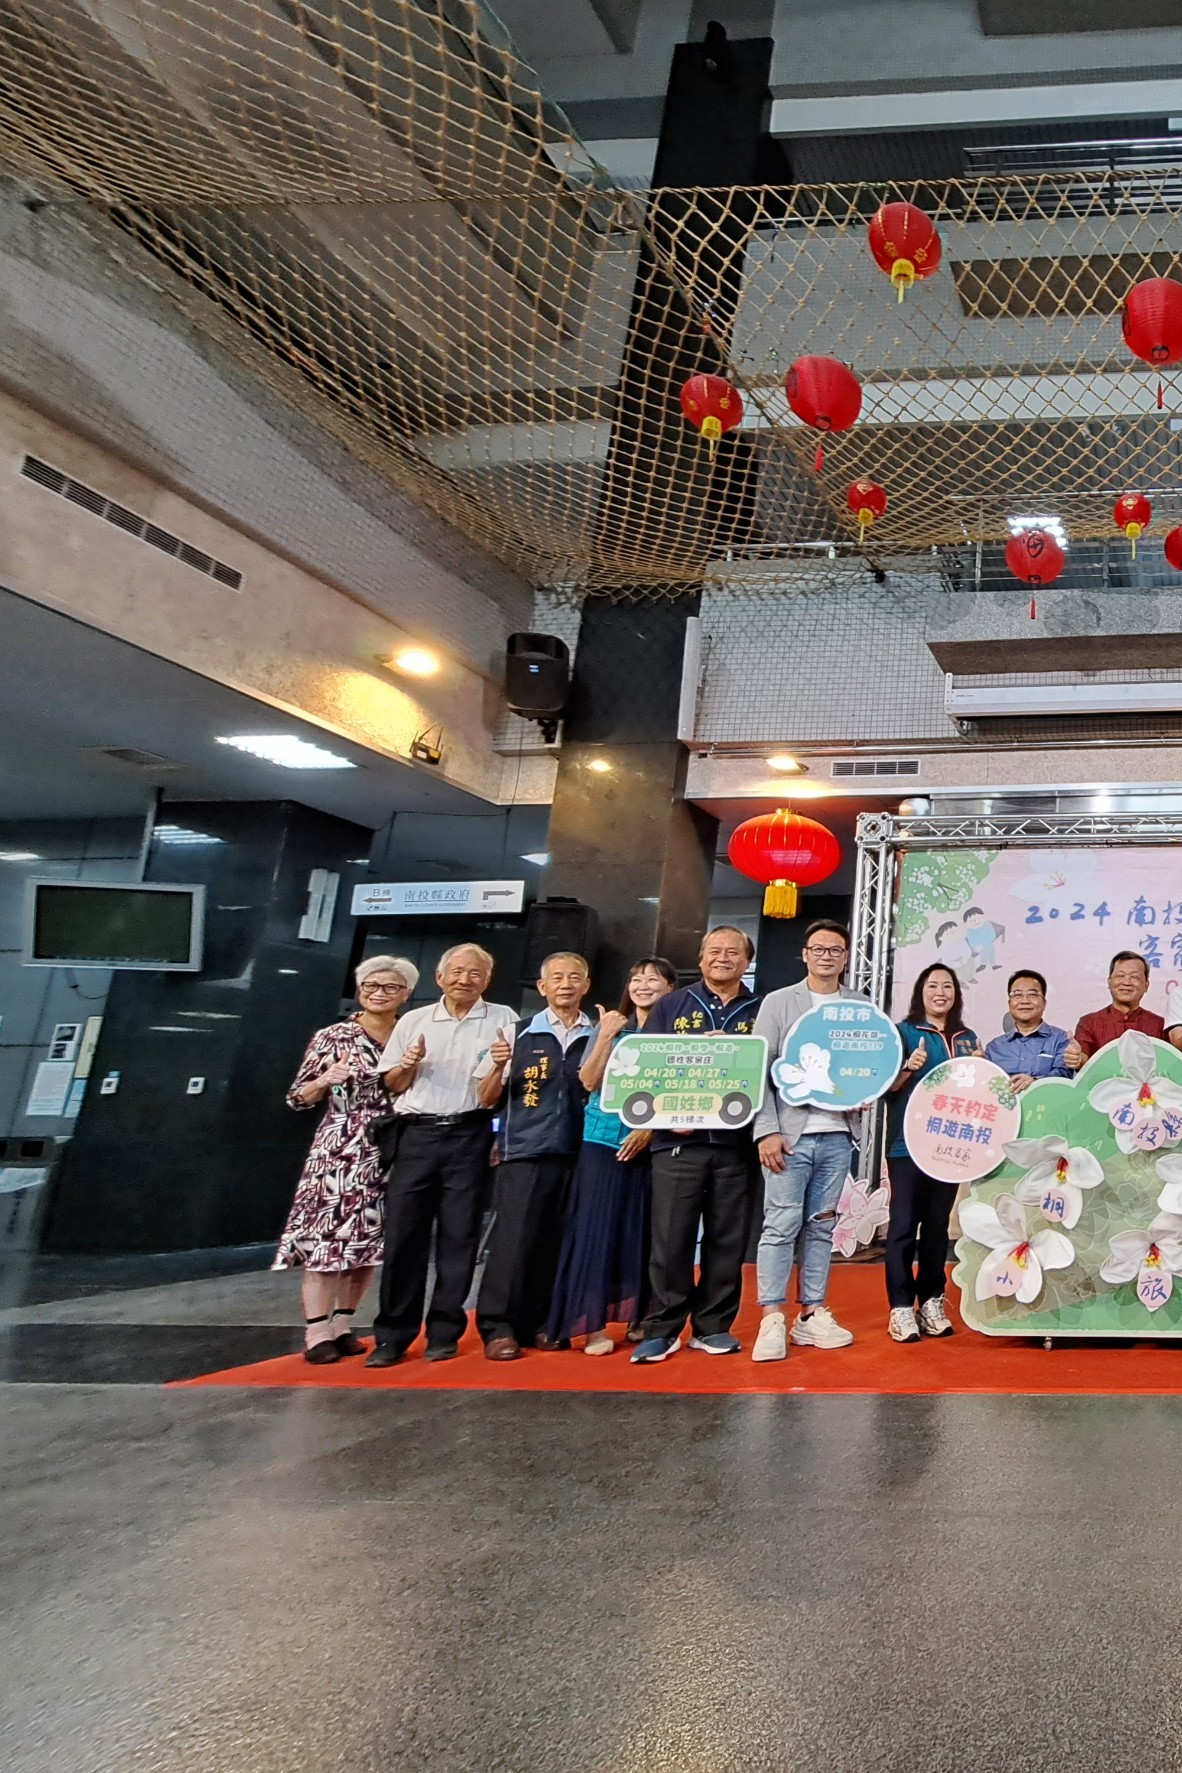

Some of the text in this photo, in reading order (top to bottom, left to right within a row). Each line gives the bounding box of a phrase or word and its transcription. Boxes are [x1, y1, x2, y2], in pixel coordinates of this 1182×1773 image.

[404, 889, 470, 901] 南投縣政府
[1025, 901, 1111, 926] 2024
[823, 1006, 872, 1022] 南投市
[523, 1066, 539, 1107] 胡水發
[662, 1095, 714, 1112] 國姓鄉
[931, 1093, 999, 1123] 春天約定
[669, 1115, 705, 1124] 共5梯次
[926, 1115, 993, 1146] 桐遊南投
